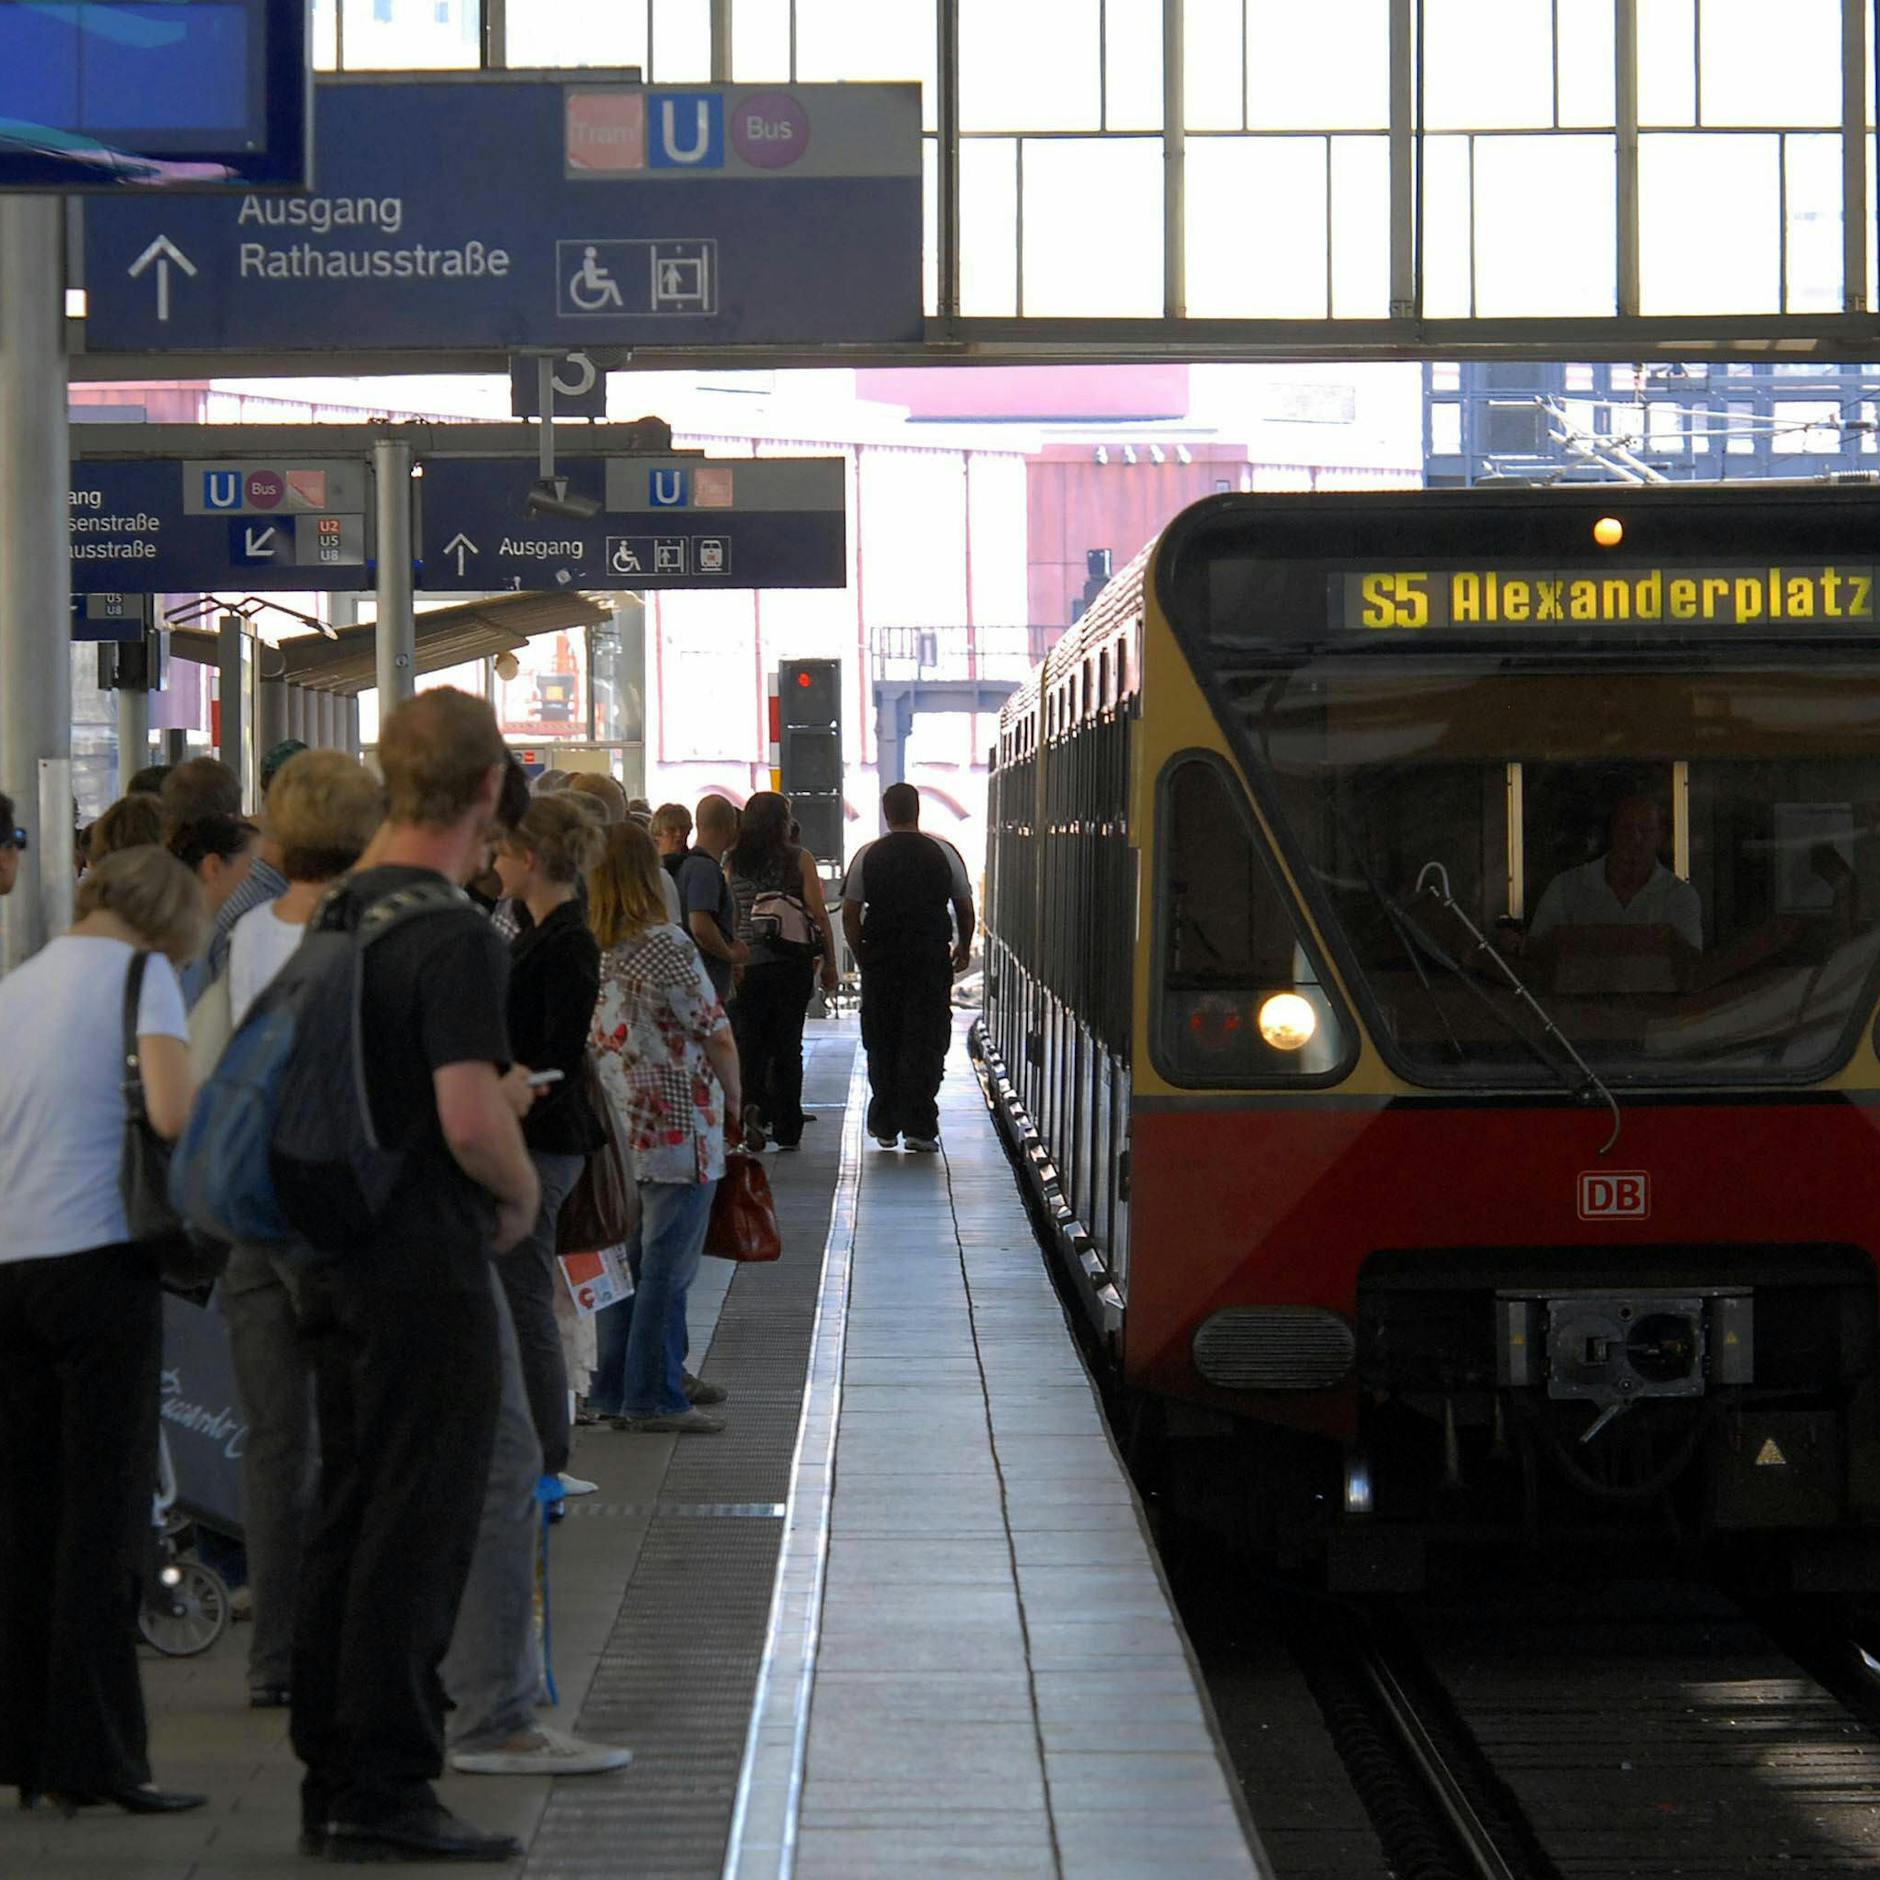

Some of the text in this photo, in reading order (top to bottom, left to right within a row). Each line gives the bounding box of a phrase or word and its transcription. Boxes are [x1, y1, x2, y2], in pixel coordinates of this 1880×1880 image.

[662, 100, 709, 163] U
[746, 115, 793, 140] Bus
[238, 194, 402, 233] Ausgang
[239, 240, 511, 278] Rathausstraße
[68, 491, 101, 509] ang
[209, 474, 235, 507] U
[251, 482, 277, 496] Bus
[655, 471, 681, 504] U
[69, 512, 160, 532] senstraße
[320, 520, 339, 532] U2
[320, 535, 339, 547] U5
[320, 550, 339, 561] U8
[499, 538, 584, 559] Ausgang
[1362, 567, 1873, 629] S5 Alexanderplatz
[1588, 1179, 1641, 1211] DB
